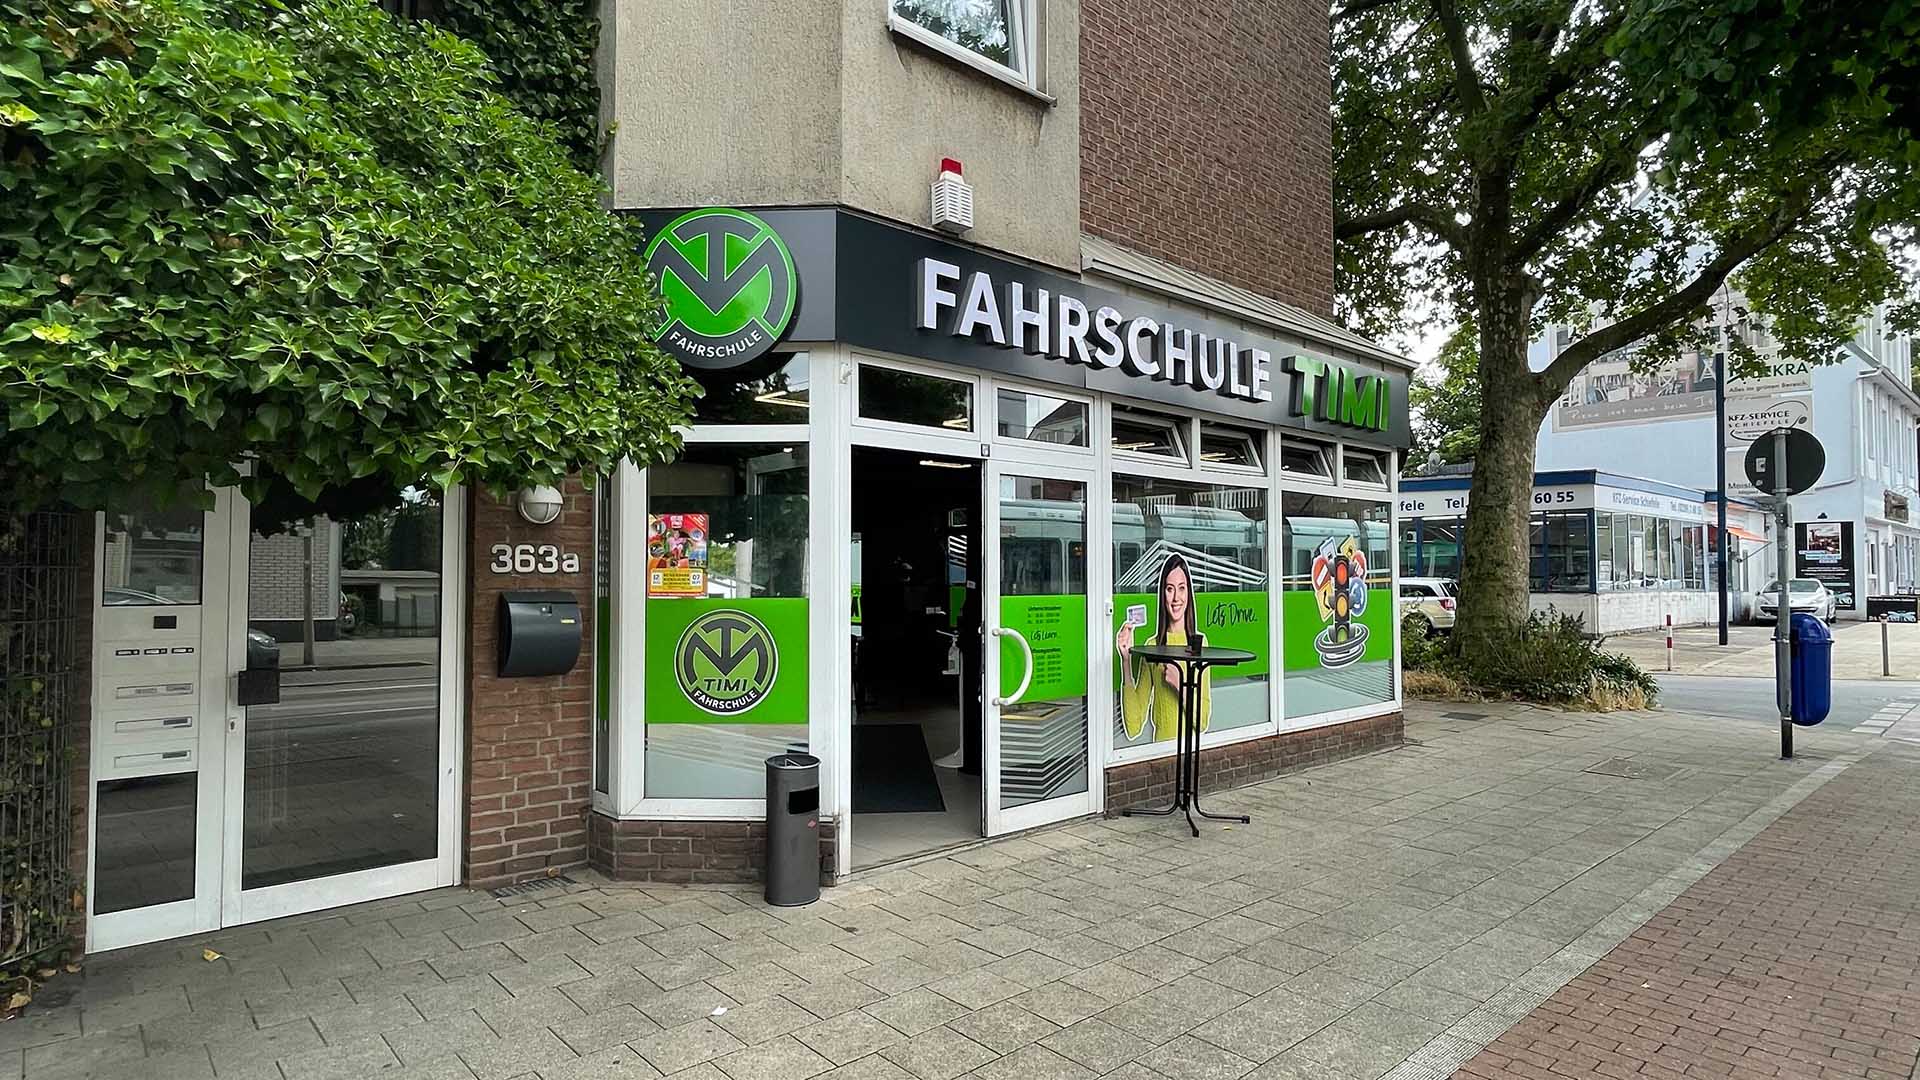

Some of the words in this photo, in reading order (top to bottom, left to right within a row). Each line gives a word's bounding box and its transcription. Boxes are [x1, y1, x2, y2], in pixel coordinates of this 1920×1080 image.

[669, 329, 762, 358] FAHRSCHULE
[918, 257, 1272, 403] FAHRSCHULE
[1283, 355, 1390, 432] TIMI
[1728, 410, 1790, 422] KFZ-SERVICE
[1534, 492, 1551, 504] 60
[1556, 491, 1575, 503] 55
[490, 544, 579, 574] 363a
[704, 678, 748, 692] TIMI
[693, 690, 757, 709] FAHRSCHULE
